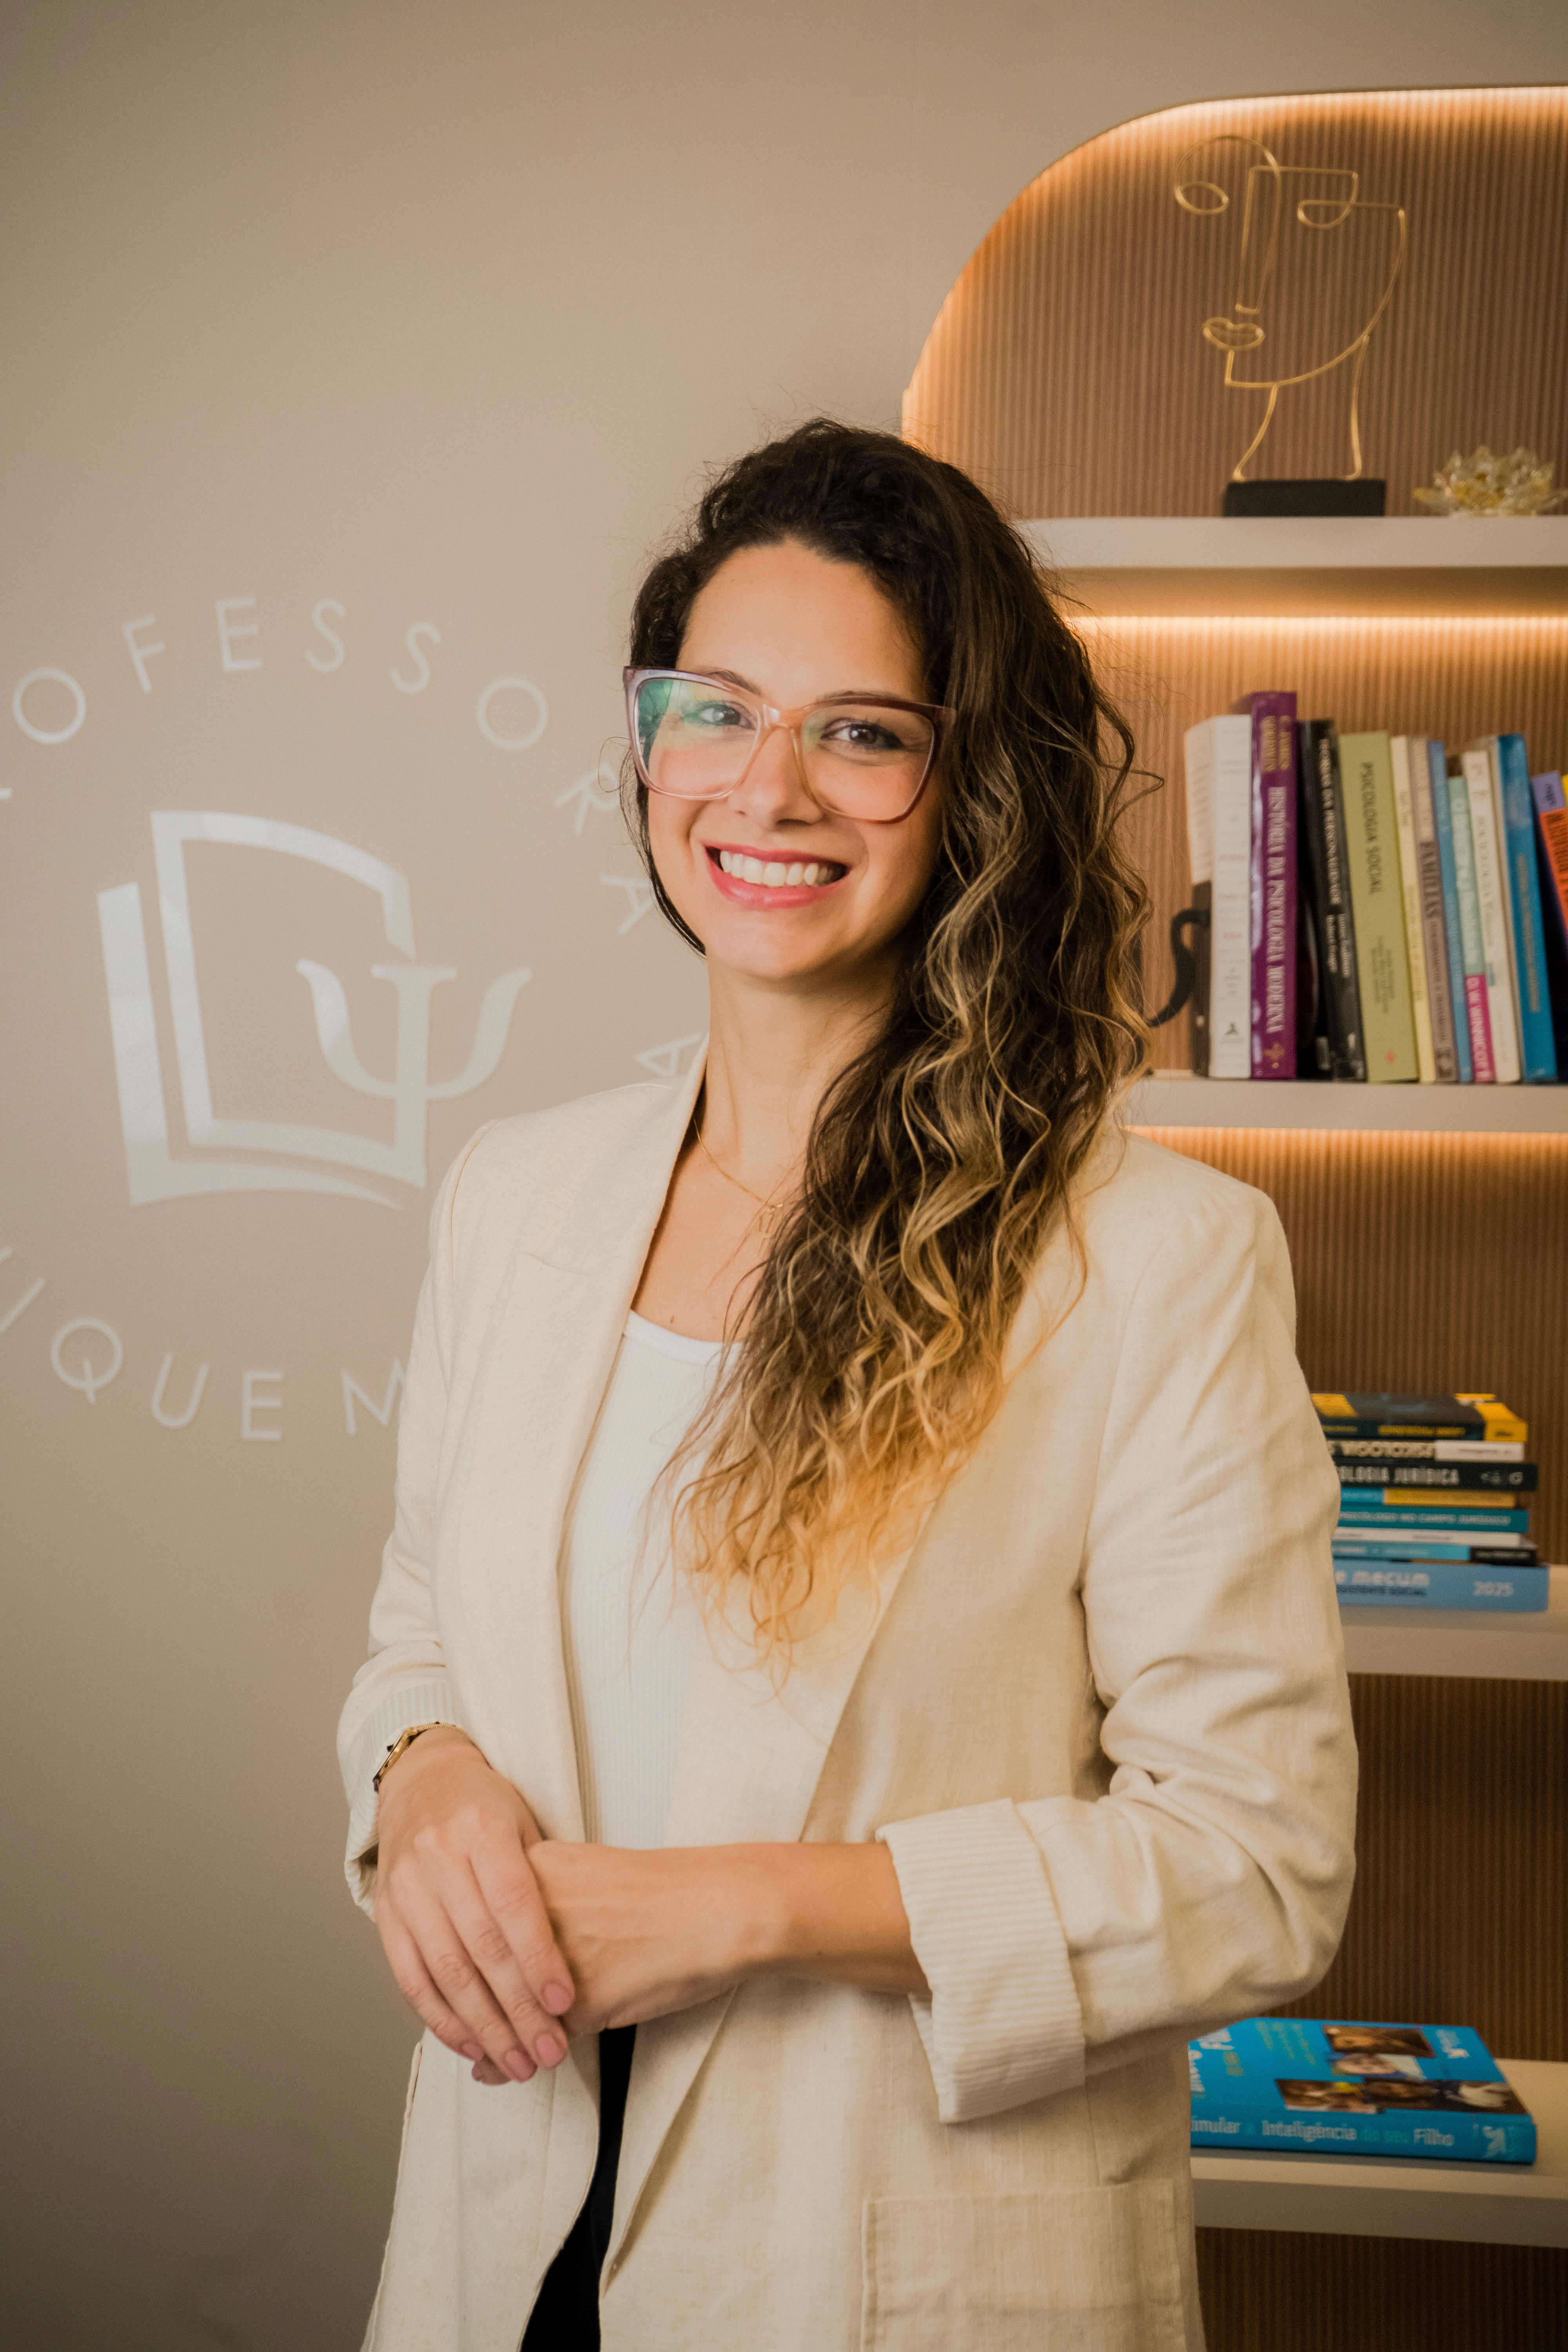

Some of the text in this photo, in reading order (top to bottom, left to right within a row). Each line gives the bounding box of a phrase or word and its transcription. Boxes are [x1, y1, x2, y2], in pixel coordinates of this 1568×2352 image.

[0, 597, 657, 935] OFESSORA
[1359, 761, 1384, 895] PSICOLOGIA SOCIAL
[1266, 786, 1289, 1034] HISTÓRIA DA PSICOLOGIA MODERNA
[1337, 1465, 1390, 1483] OLOGIA
[1473, 1581, 1514, 1597] 2025
[1262, 2120, 1357, 2143] Inteligência
[1413, 2128, 1454, 2146] Filho
